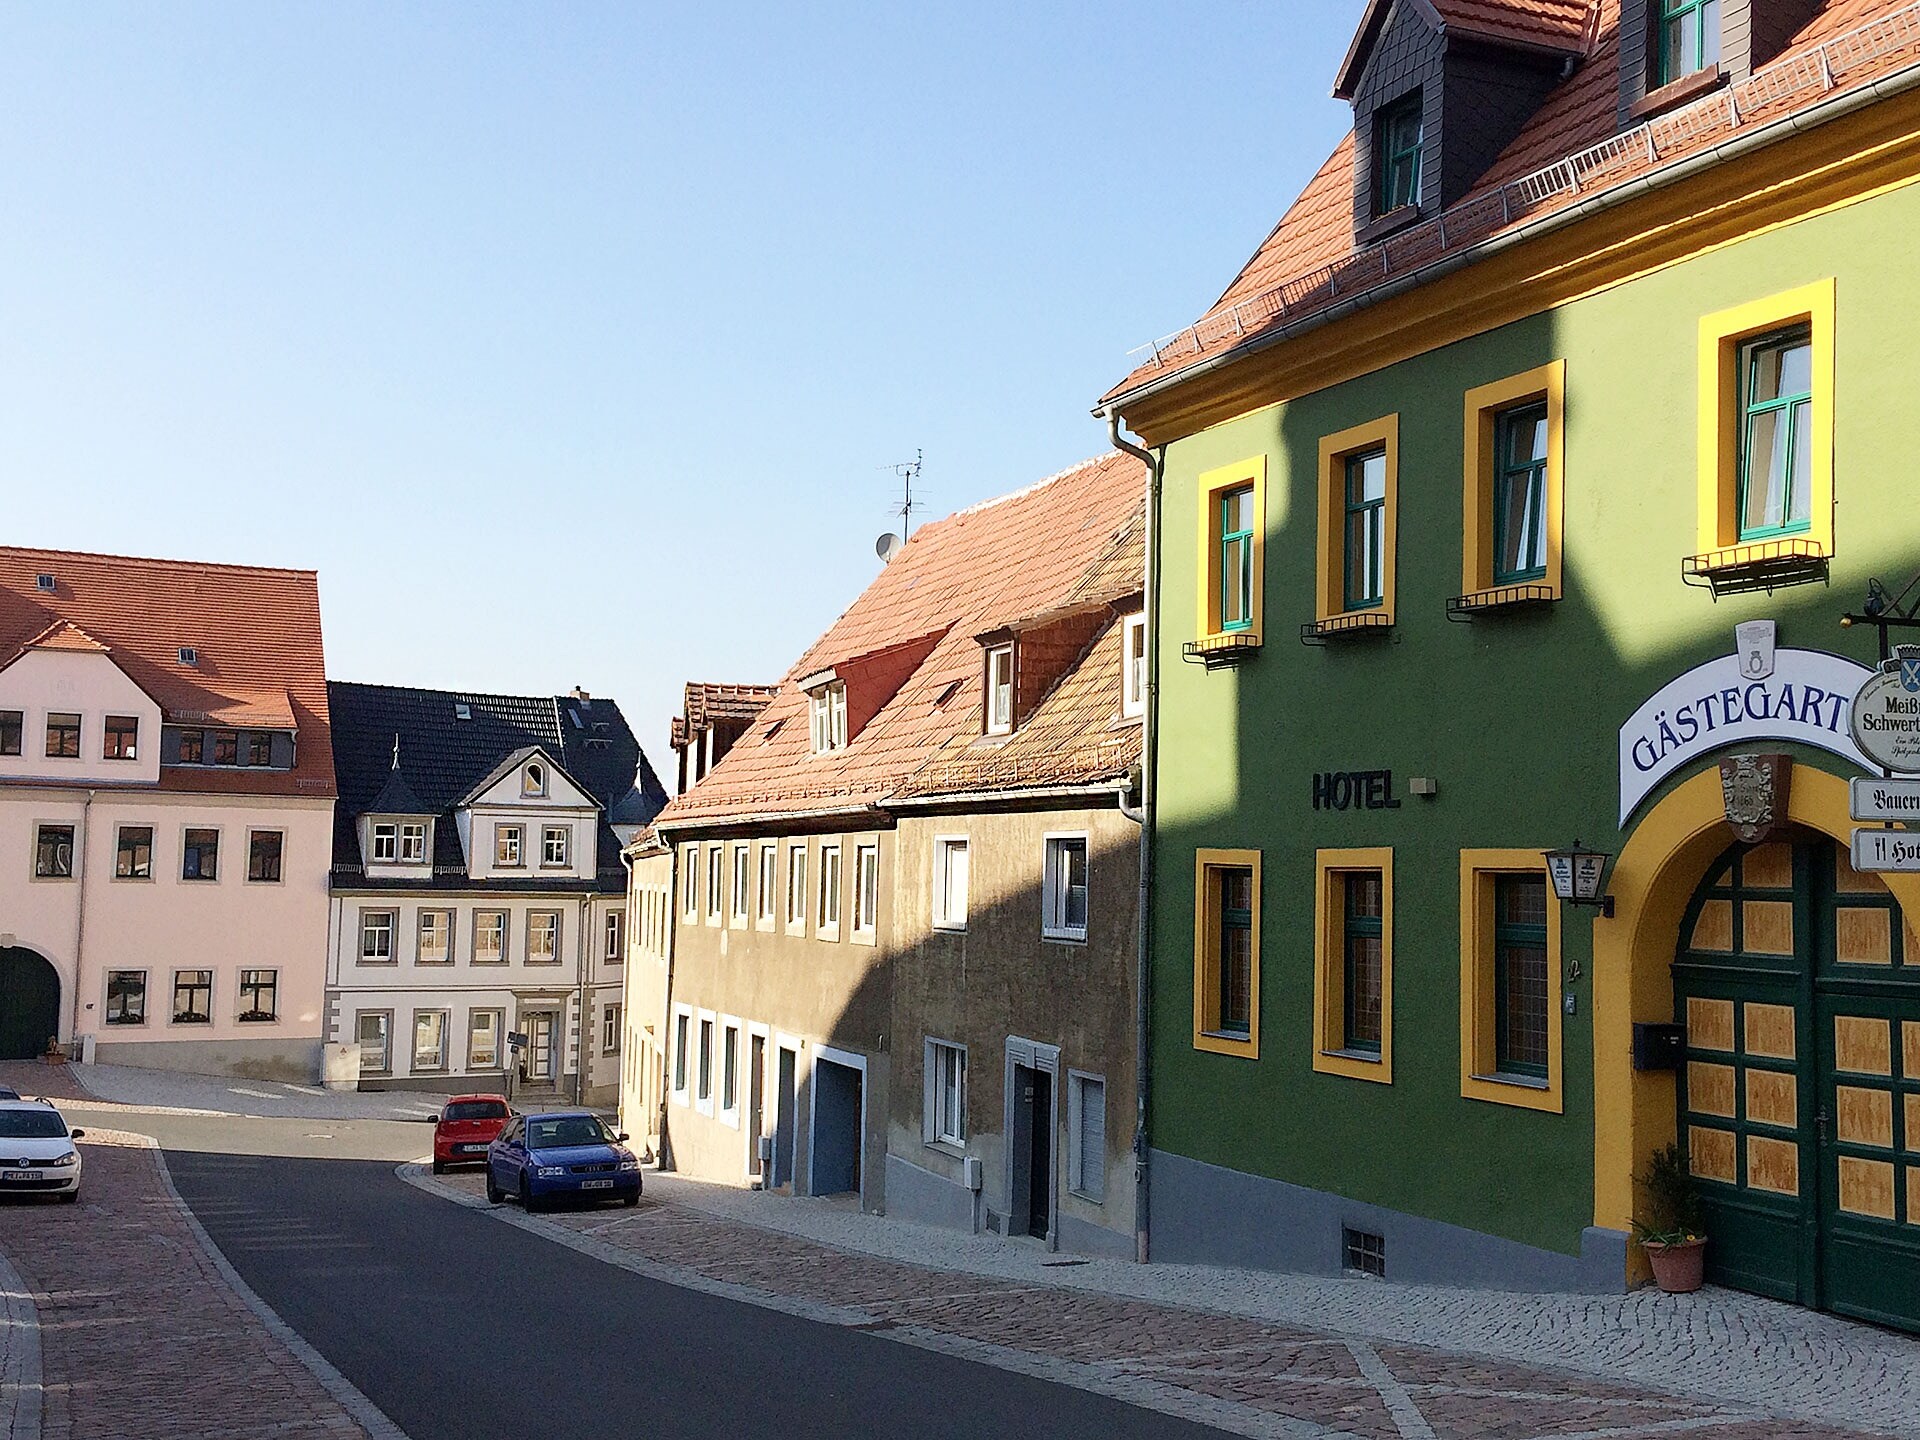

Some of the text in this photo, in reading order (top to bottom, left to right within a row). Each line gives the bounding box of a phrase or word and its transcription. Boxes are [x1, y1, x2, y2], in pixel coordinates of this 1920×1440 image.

[1885, 696, 1920, 714] Meiß
[1632, 682, 1849, 772] GÄSTEGART
[1312, 769, 1400, 811] HOTEL
